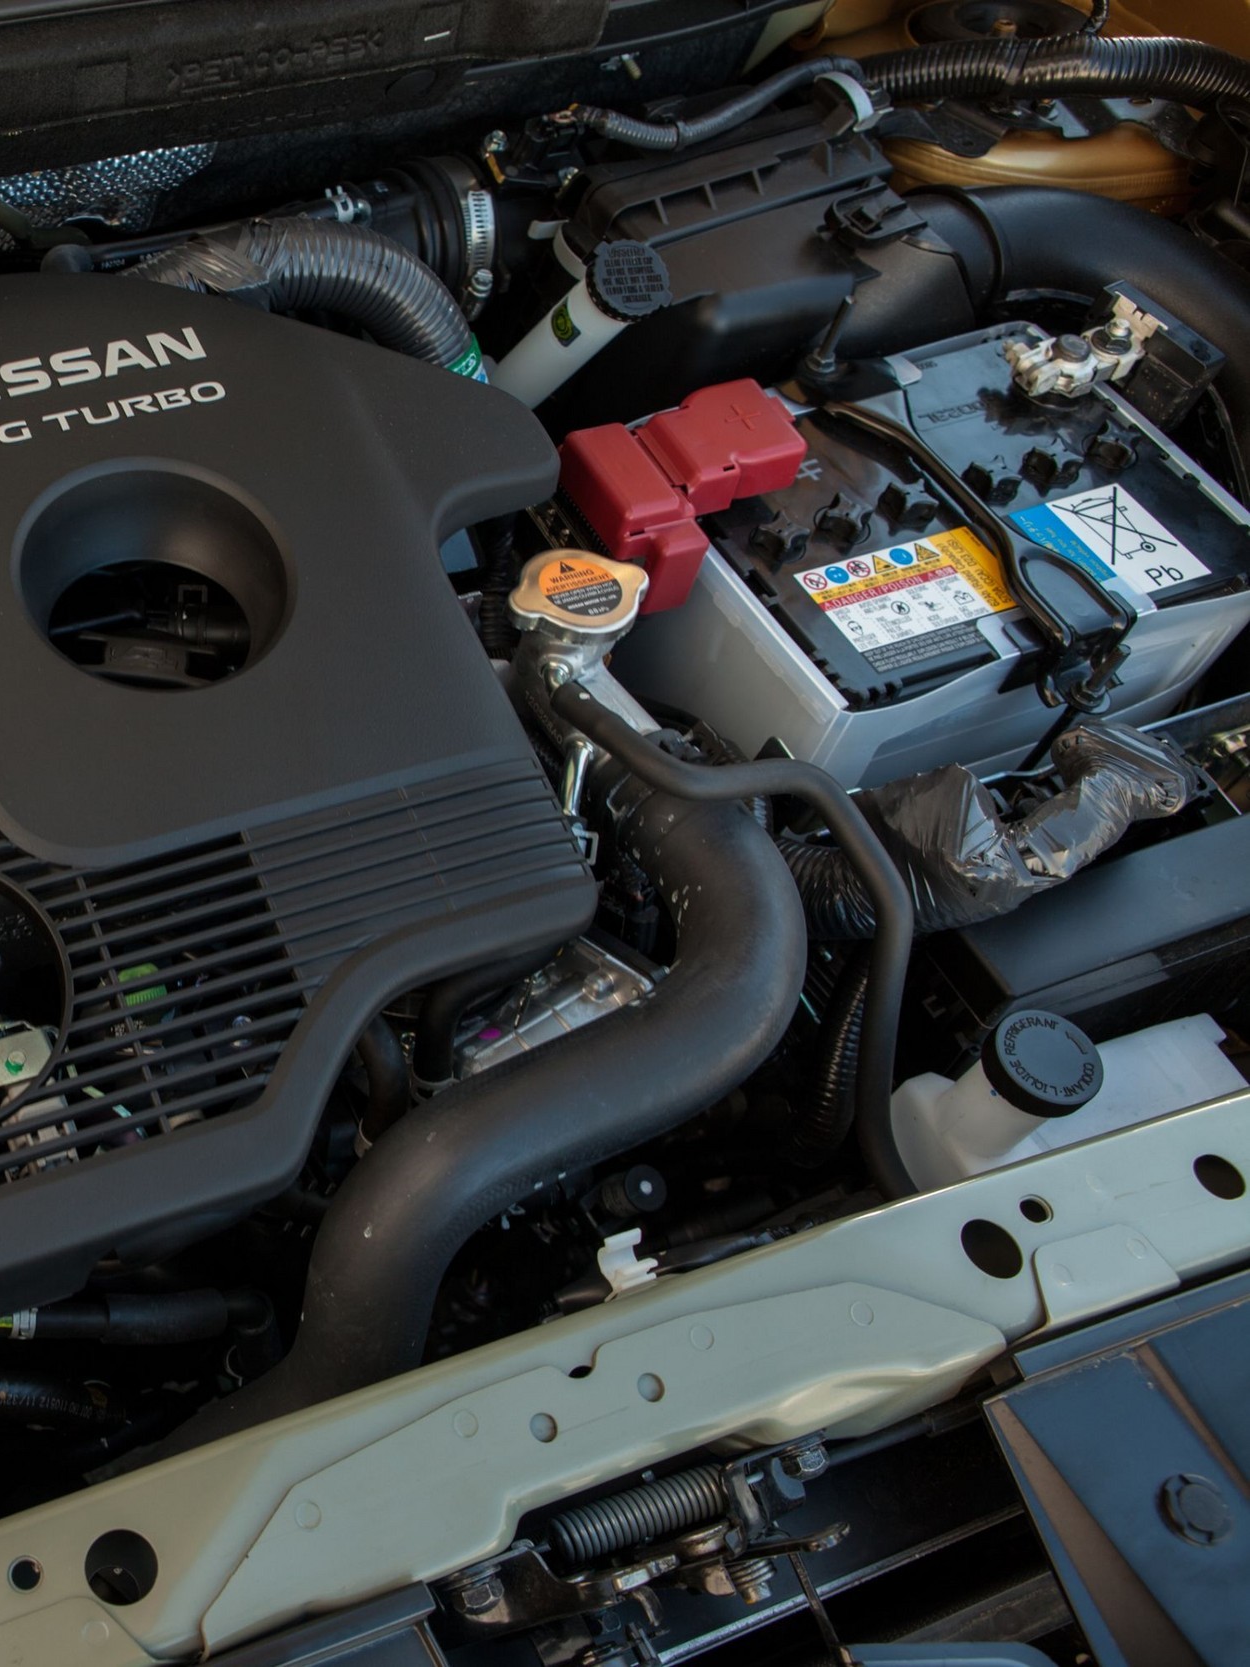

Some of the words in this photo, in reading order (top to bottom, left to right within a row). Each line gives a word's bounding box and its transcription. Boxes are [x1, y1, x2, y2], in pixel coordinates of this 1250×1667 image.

[42, 381, 226, 432] TURBO
[546, 573, 610, 593] AVERTISSEMENT
[550, 568, 595, 584] WARNING
[1144, 565, 1185, 587] Pb
[1003, 1016, 1059, 1057] REFRIGERANT
